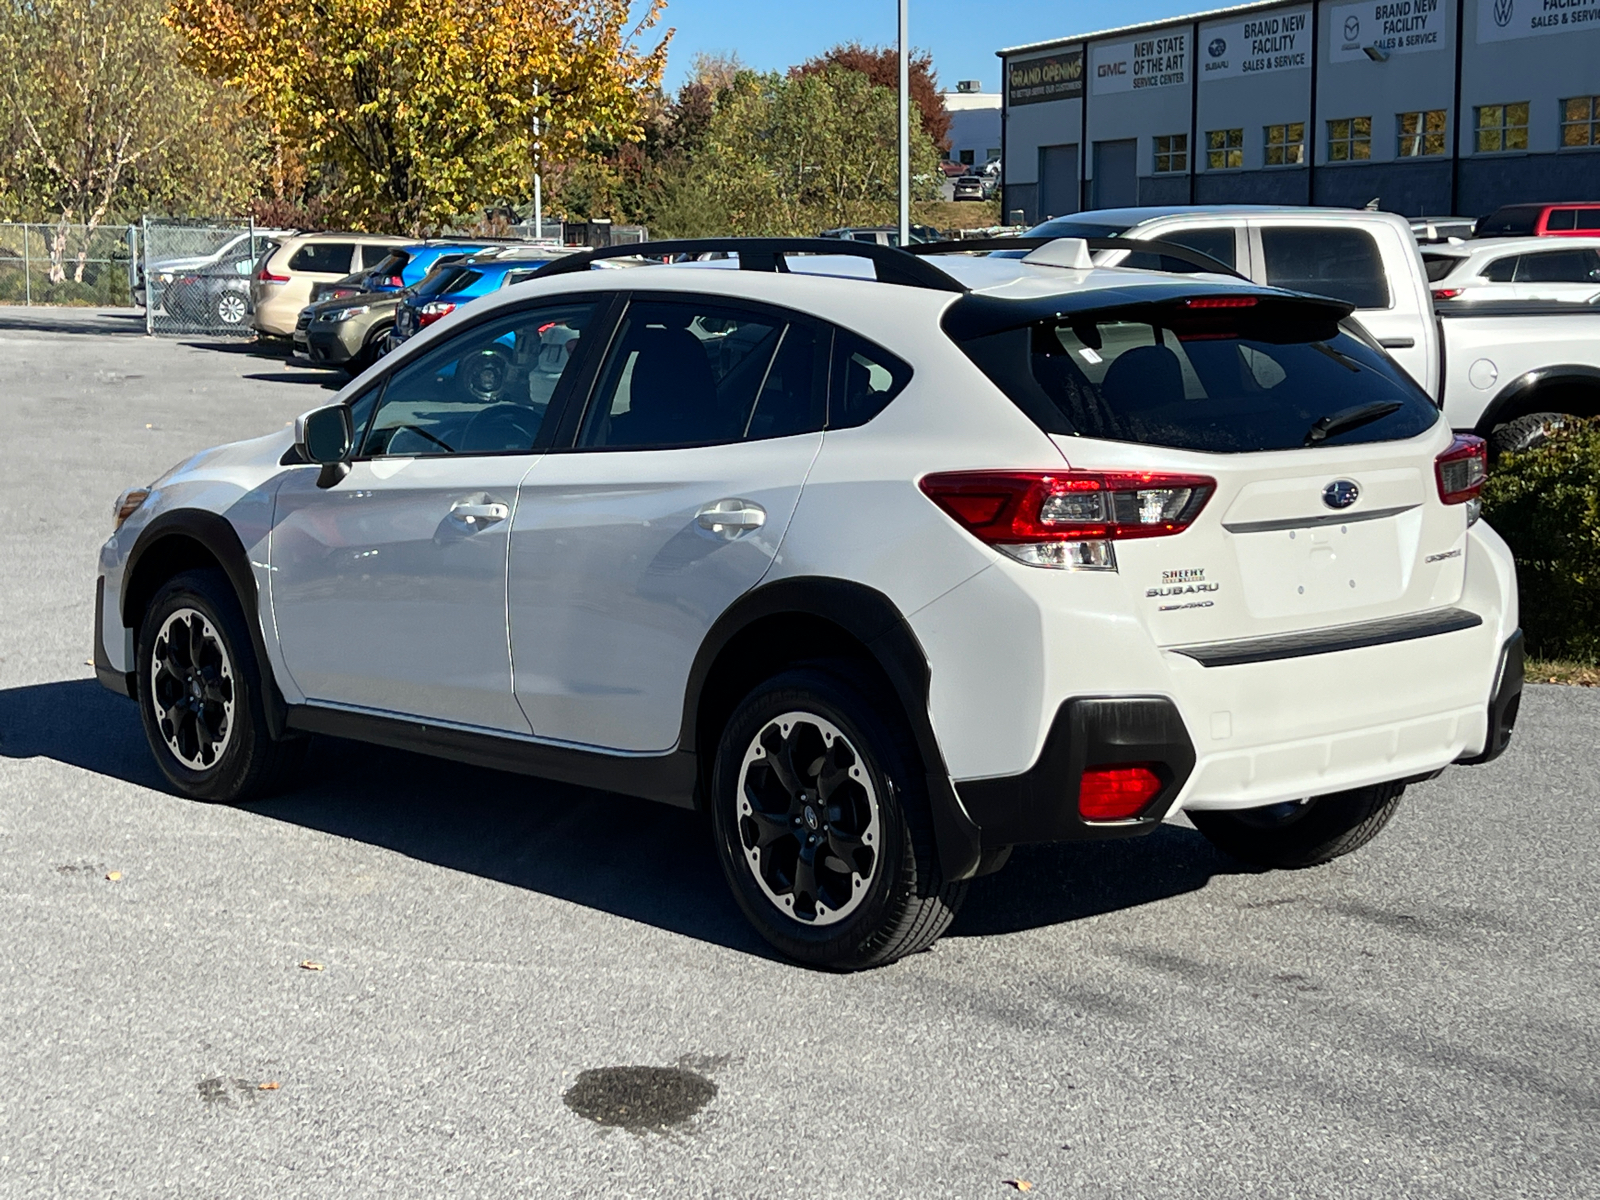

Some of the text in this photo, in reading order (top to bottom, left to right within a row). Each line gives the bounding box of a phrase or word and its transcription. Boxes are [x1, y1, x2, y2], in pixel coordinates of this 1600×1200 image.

[1375, 0, 1438, 21] BRAND NEW
[1531, 14, 1559, 29] SALES
[1561, 12, 1568, 24] &
[1244, 14, 1306, 39] BRAND NEW
[1383, 14, 1428, 35] FACILITY
[1134, 35, 1184, 58] NEW STATE
[1251, 34, 1296, 55] FACILITY
[1397, 36, 1404, 48] &
[1405, 31, 1438, 46] SERVICE
[1097, 61, 1127, 78] GMC
[1133, 54, 1185, 75] OF THE ART
[1242, 52, 1305, 73] SALES & SERVICE
[1011, 60, 1081, 87] GRAND OPENING
[1133, 72, 1184, 89] SERVICE CENTER
[1145, 583, 1219, 597] SUBARU
